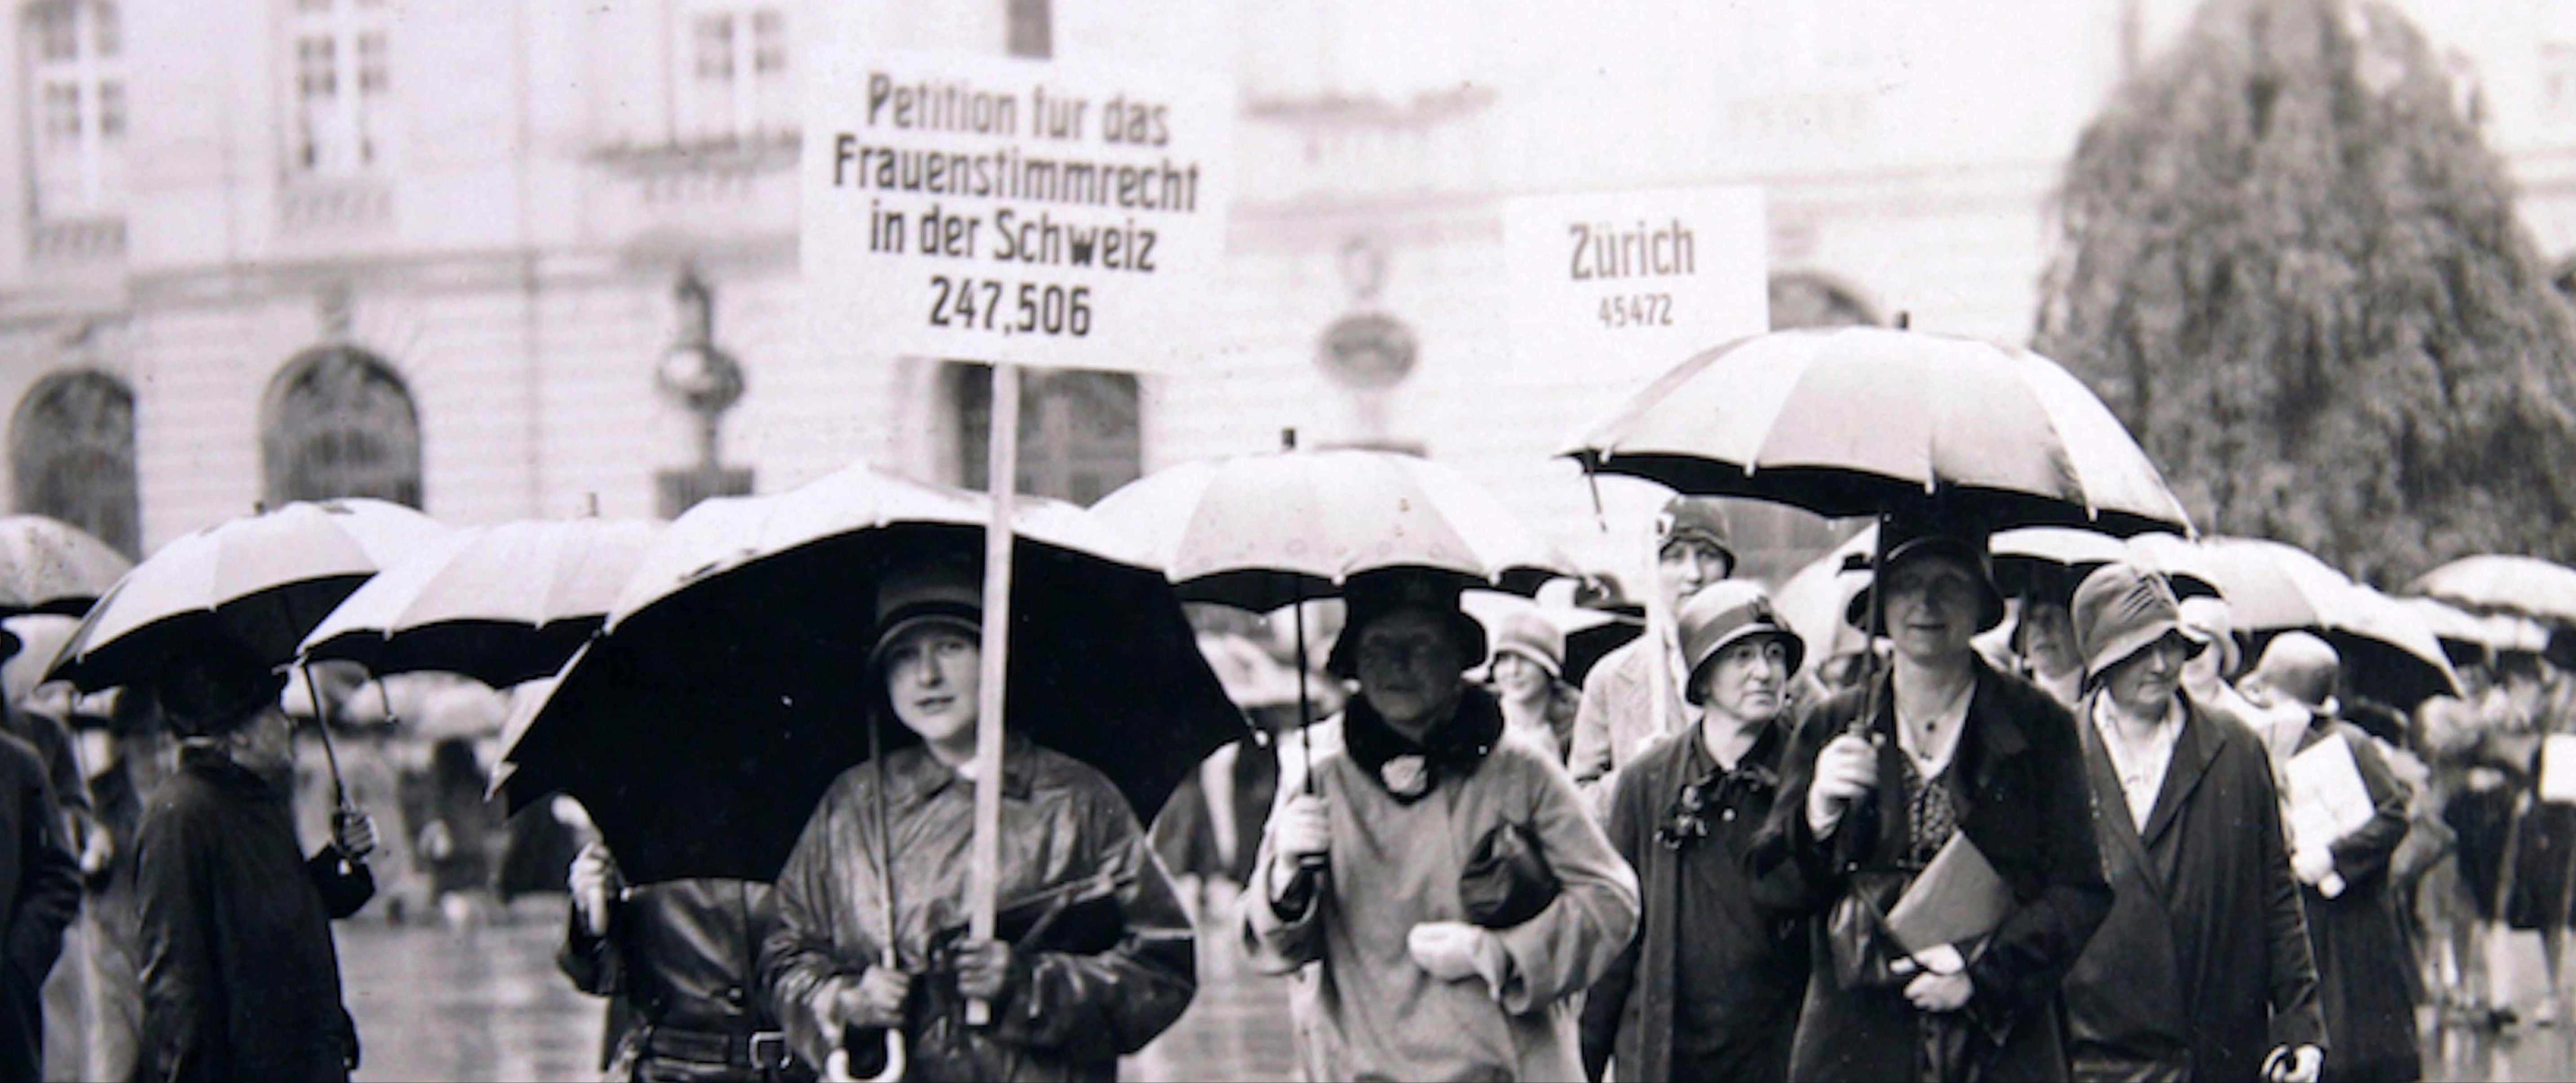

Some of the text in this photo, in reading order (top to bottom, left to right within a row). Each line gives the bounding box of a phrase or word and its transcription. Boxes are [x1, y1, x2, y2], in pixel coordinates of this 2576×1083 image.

[865, 71, 1016, 136] Petition
[1102, 95, 1170, 149] das
[832, 131, 1200, 213] Frauenstimmrecht
[868, 197, 1159, 274] in der Schweiz
[1568, 217, 1696, 282] Zürich
[927, 273, 1093, 340] 247,506
[1598, 293, 1673, 328] 45472
